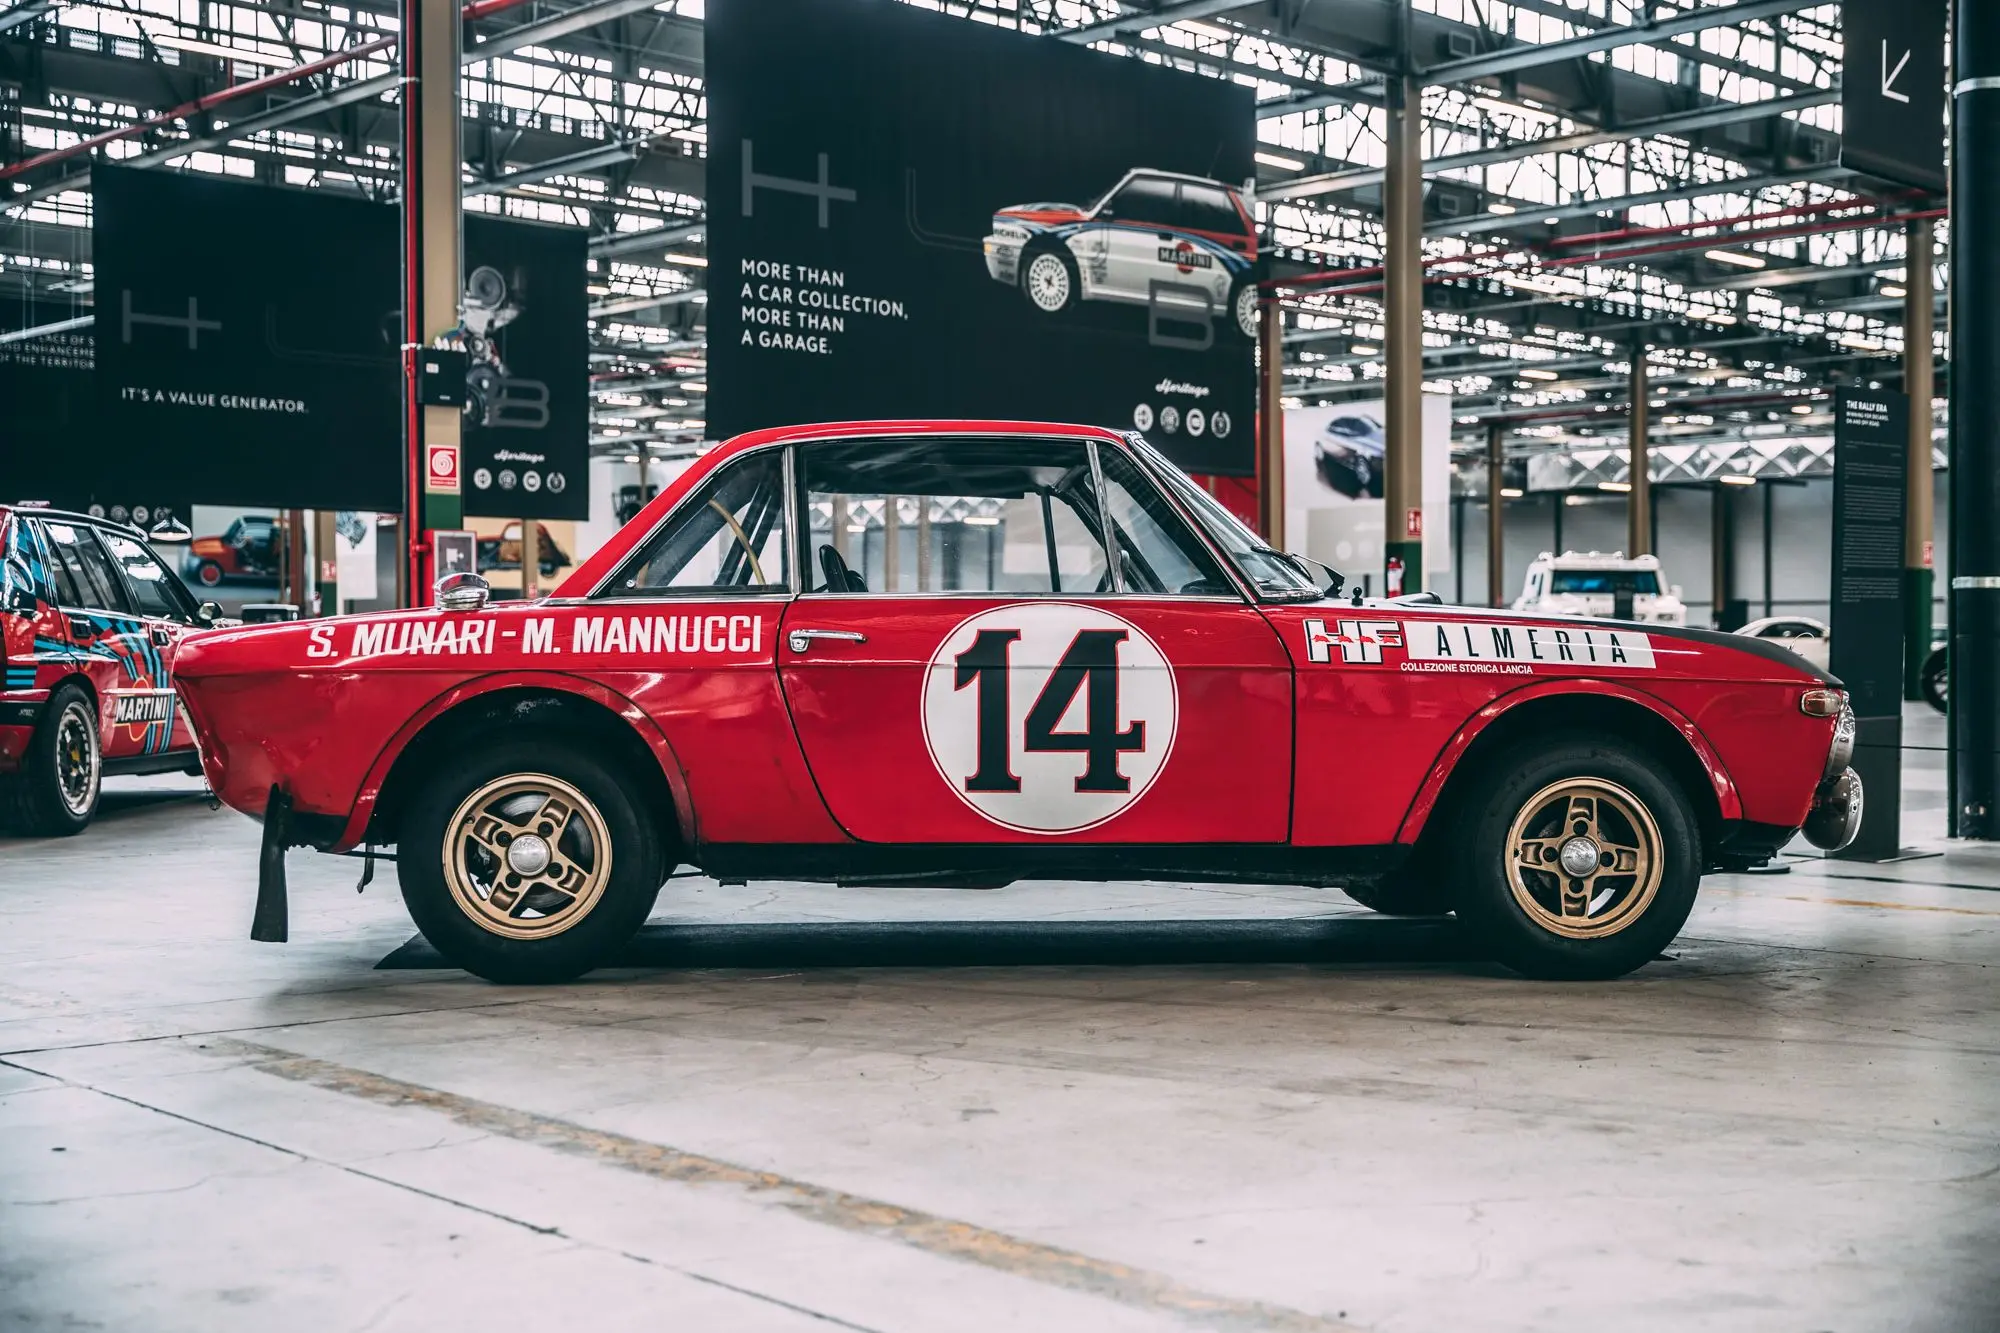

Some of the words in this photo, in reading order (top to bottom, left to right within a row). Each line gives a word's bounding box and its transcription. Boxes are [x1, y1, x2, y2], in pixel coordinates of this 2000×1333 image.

[1159, 249, 1211, 267] MARTINI
[741, 258, 791, 280] MORE
[796, 266, 844, 287] THAN
[741, 282, 753, 299] A
[759, 284, 792, 304] CAR
[798, 289, 908, 320] COLLECTION.
[741, 305, 791, 327] MORE
[796, 312, 844, 332] THAN
[741, 329, 753, 346] A
[759, 331, 832, 354] GARAGE.
[15, 353, 37, 366] THE
[121, 387, 150, 402] IT'S
[154, 389, 165, 402] A
[168, 391, 215, 408] VALUE
[220, 395, 310, 413] GENERATOR.
[1155, 378, 1210, 398] Heritage
[1846, 400, 1858, 410] THE
[1858, 401, 1875, 411] RALLY
[1876, 403, 1888, 413] ERA
[307, 625, 339, 658] S.
[351, 619, 496, 657] MUNARI
[522, 618, 561, 654] M.
[572, 615, 762, 654] MANNUCCI
[1302, 619, 1403, 665] HF
[1437, 624, 1627, 664] ALMERIA
[1400, 662, 1458, 673] COLLEZIONE
[1458, 663, 1499, 674] STORICA
[1500, 665, 1534, 675] LANCIA
[115, 697, 168, 722] MARTINI
[954, 628, 1146, 793] 14
